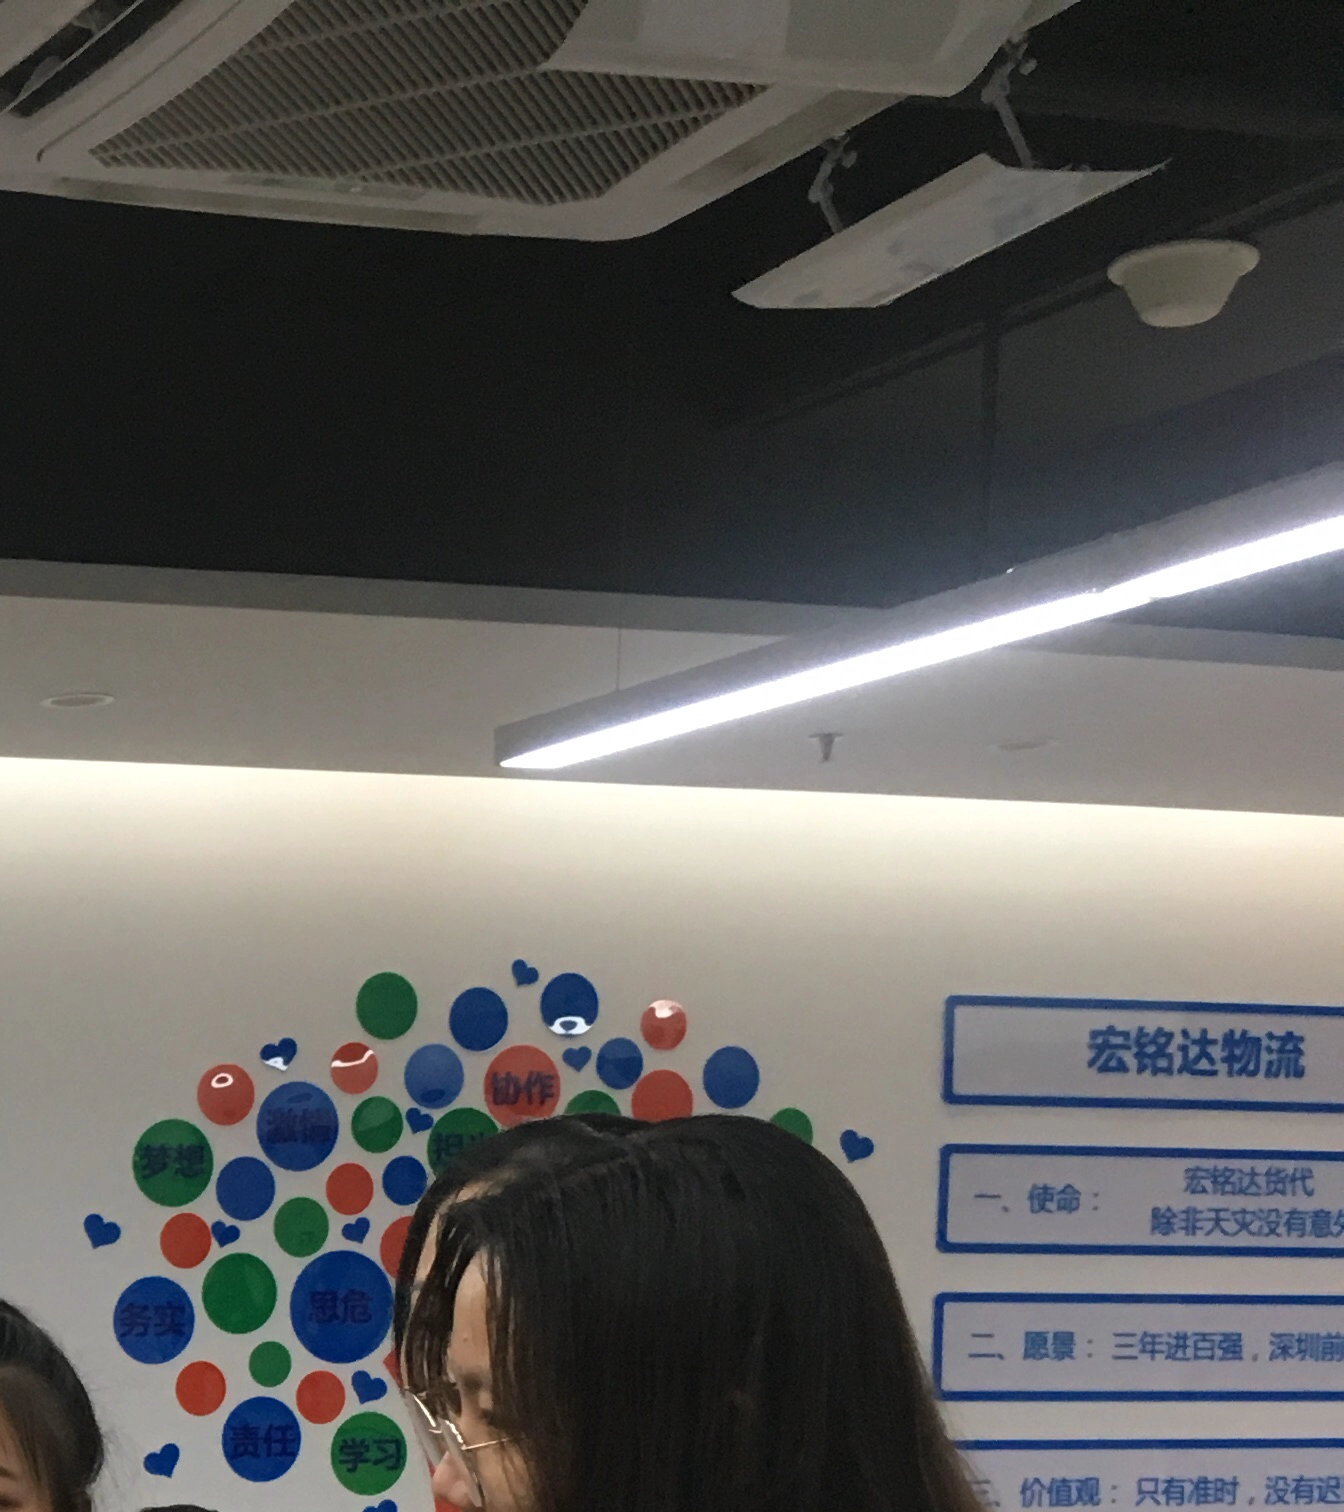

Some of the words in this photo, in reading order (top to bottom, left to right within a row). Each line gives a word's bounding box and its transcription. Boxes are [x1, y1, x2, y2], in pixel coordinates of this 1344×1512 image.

[1087, 1025, 1306, 1079] 宏铭达物流
[491, 1070, 555, 1106] 协作
[141, 1144, 205, 1179] 梦想
[1183, 1165, 1315, 1197] 宏铭达货代
[120, 1302, 186, 1338] 务实
[230, 1424, 297, 1459] 责任
[339, 1438, 402, 1473] 学习
